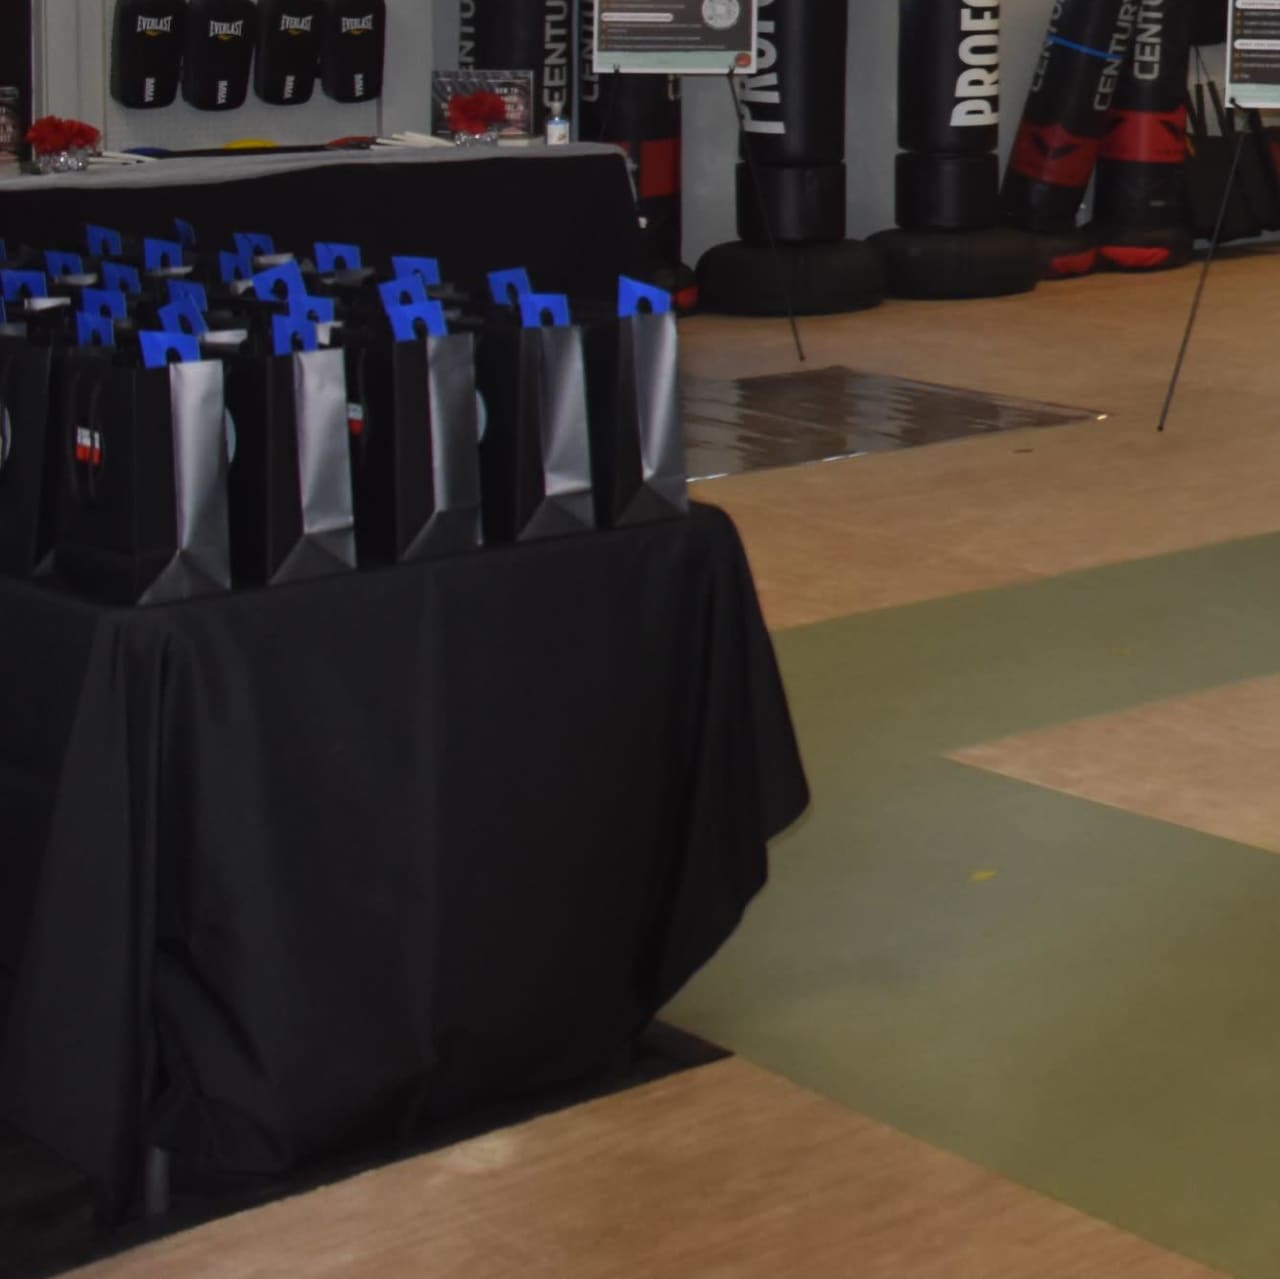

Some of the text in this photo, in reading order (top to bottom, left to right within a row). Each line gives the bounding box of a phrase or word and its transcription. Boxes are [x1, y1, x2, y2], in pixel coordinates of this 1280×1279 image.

[136, 15, 174, 32] EVERLAST
[208, 19, 244, 37] EVERLAST
[279, 14, 314, 32] EVERLAST
[340, 14, 374, 32] EVERLAST
